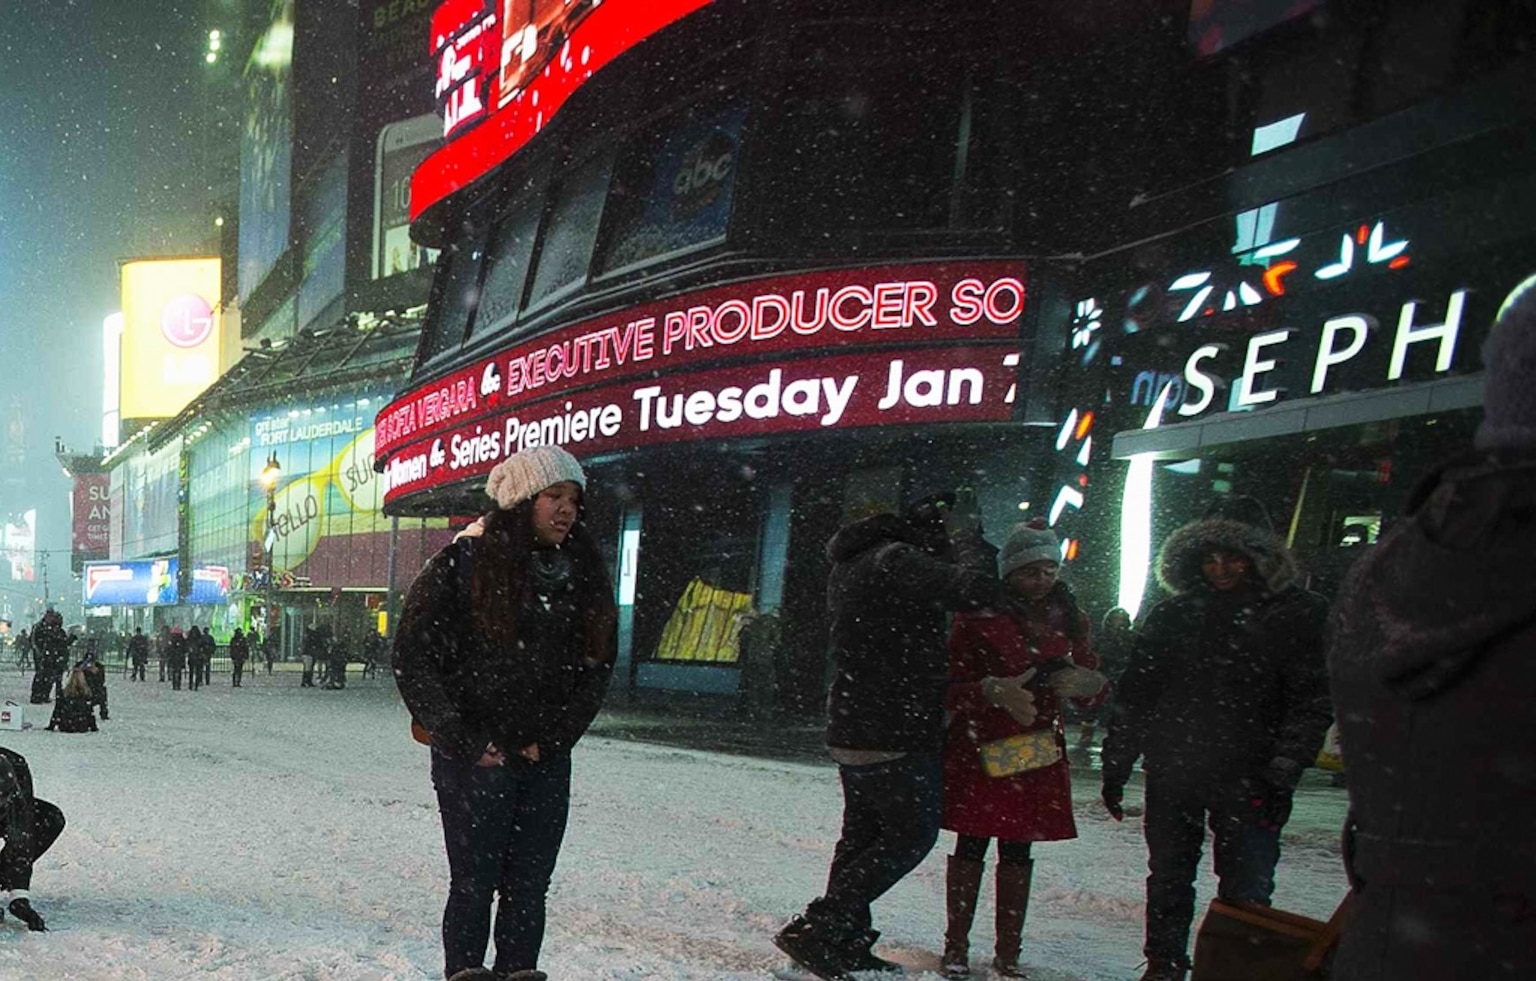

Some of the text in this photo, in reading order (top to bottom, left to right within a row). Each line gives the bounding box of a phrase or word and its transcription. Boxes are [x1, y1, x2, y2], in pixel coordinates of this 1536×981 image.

[673, 150, 732, 194] abc
[417, 376, 476, 429] VERGARA
[506, 317, 656, 396] EXECUTIVE
[663, 278, 938, 356] PRODUCER
[950, 277, 1025, 325] SO
[1177, 274, 1536, 417] SEPH
[261, 416, 363, 446] FORT LAUDERDALE
[450, 426, 501, 470] Series
[505, 401, 622, 458] Premiere
[633, 368, 859, 426] Tuesday
[877, 359, 985, 411] Jan
